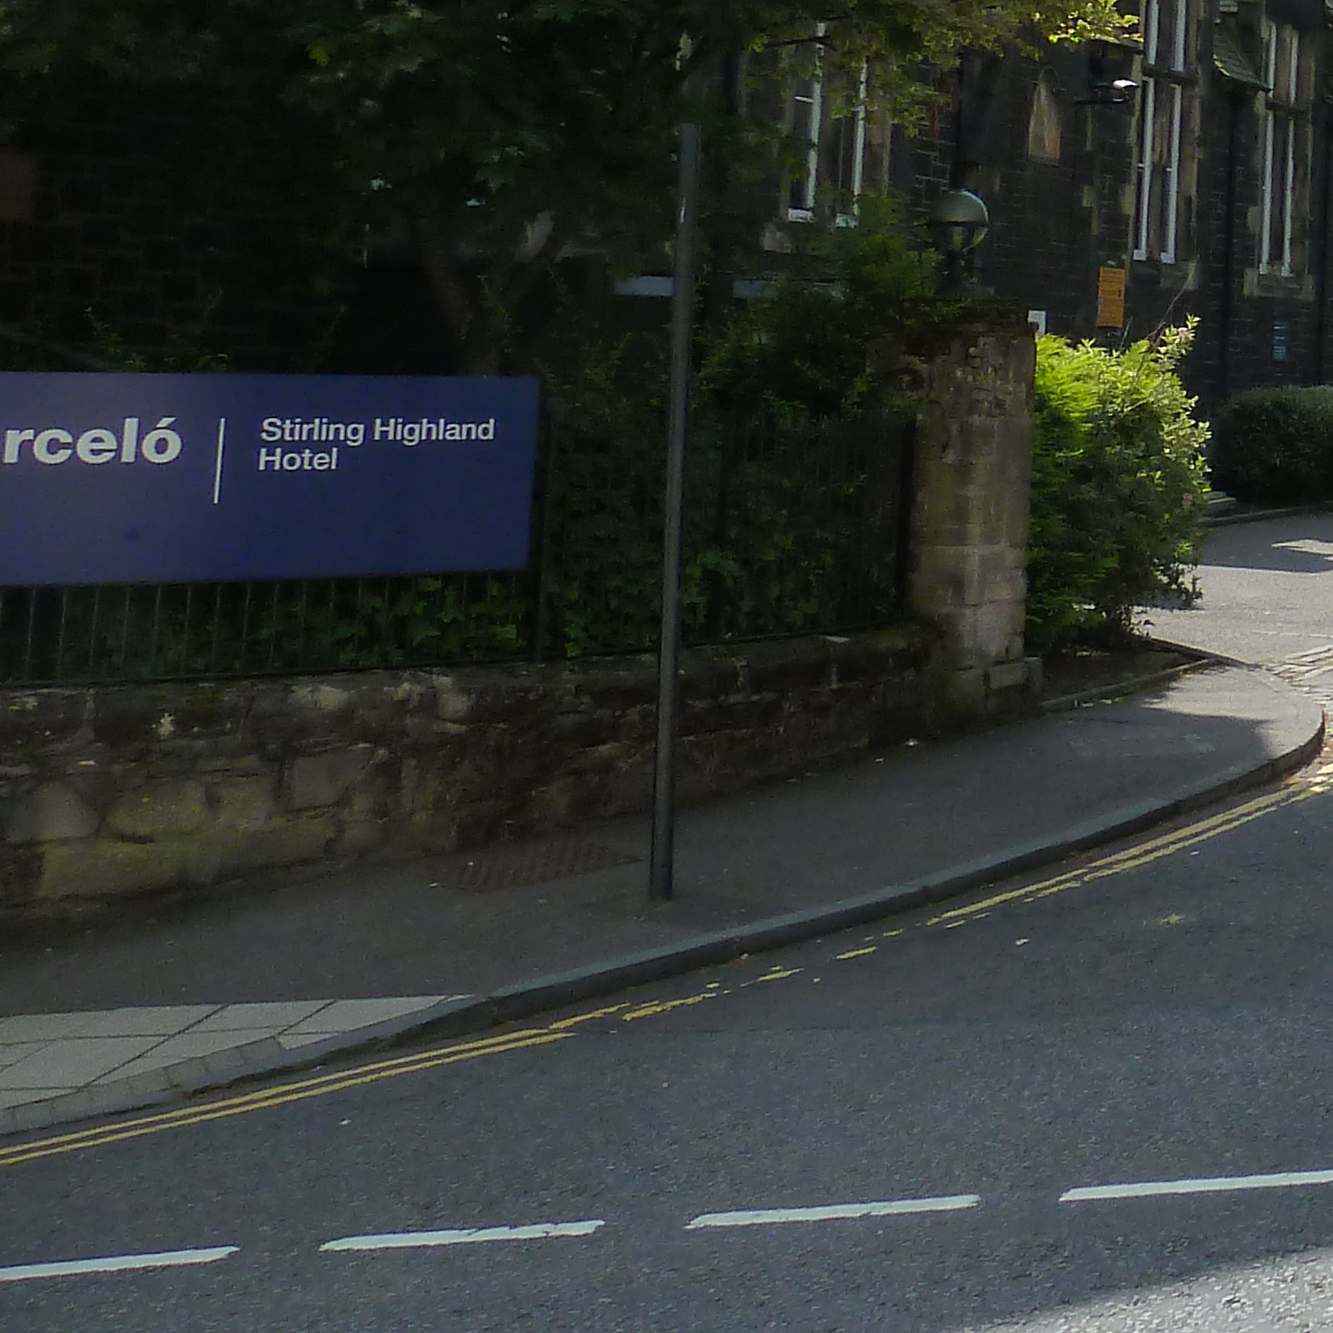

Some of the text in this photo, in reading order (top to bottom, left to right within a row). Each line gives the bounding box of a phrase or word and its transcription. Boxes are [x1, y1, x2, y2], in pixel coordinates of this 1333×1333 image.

[4, 417, 182, 465] rceló
[261, 417, 496, 447] Stirling Highland
[258, 447, 339, 471] Hotel
